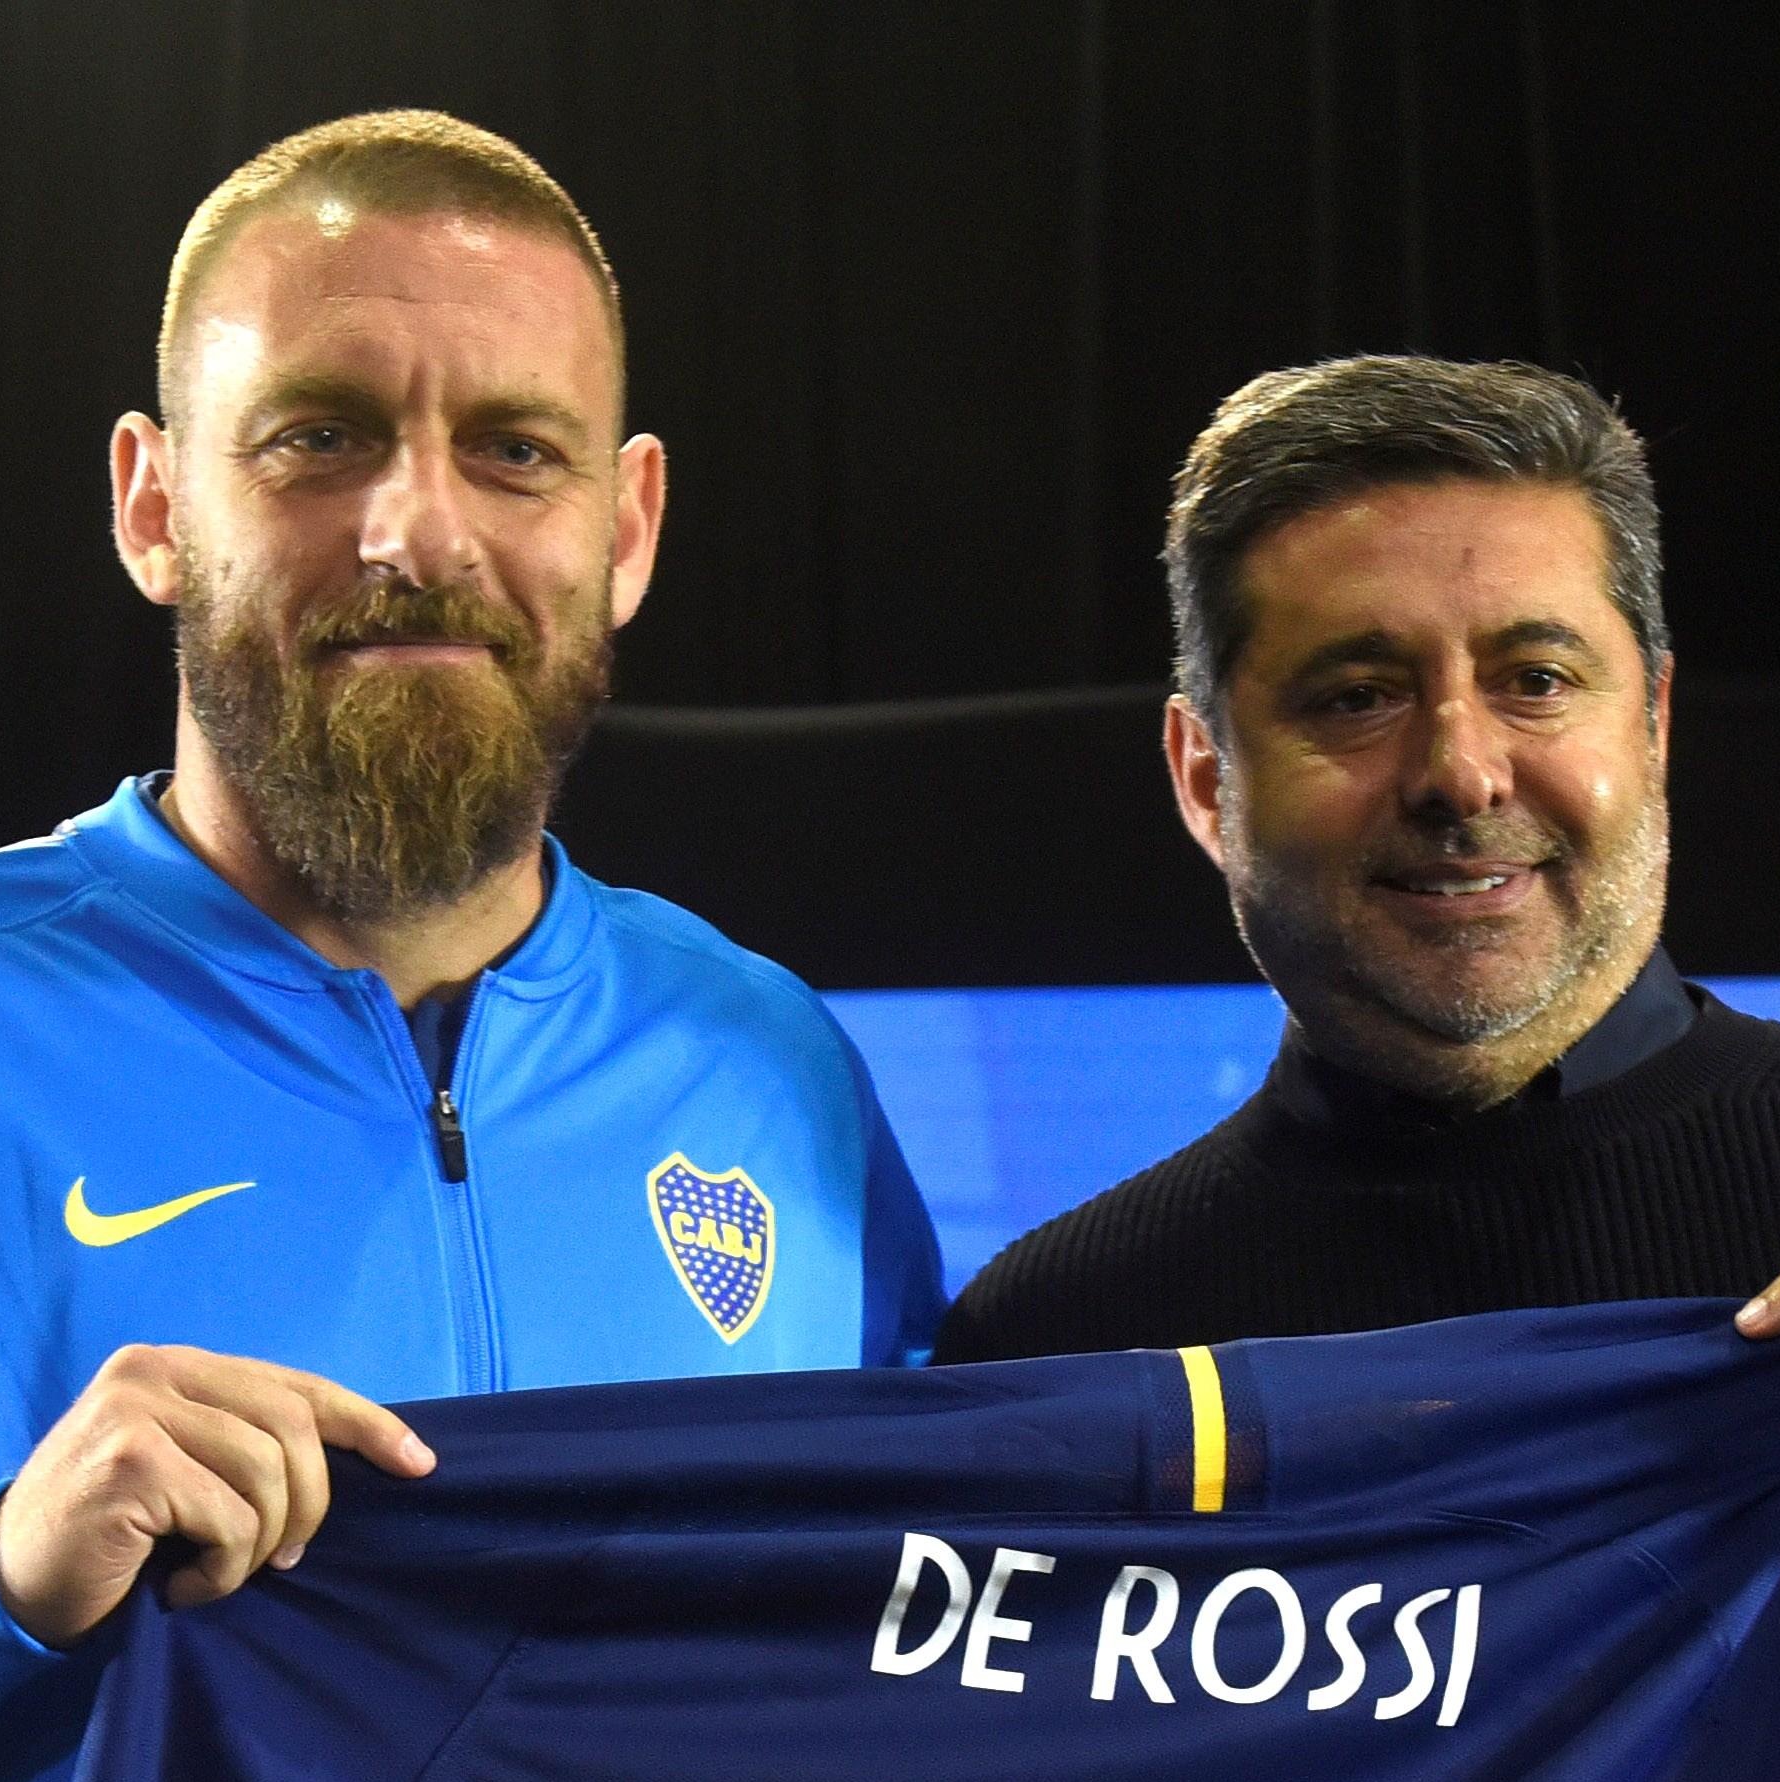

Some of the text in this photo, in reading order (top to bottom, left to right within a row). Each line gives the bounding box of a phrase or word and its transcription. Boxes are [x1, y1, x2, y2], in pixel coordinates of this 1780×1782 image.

[670, 1210, 762, 1264] CABJ
[870, 1532, 1482, 1727] DE ROSSI
